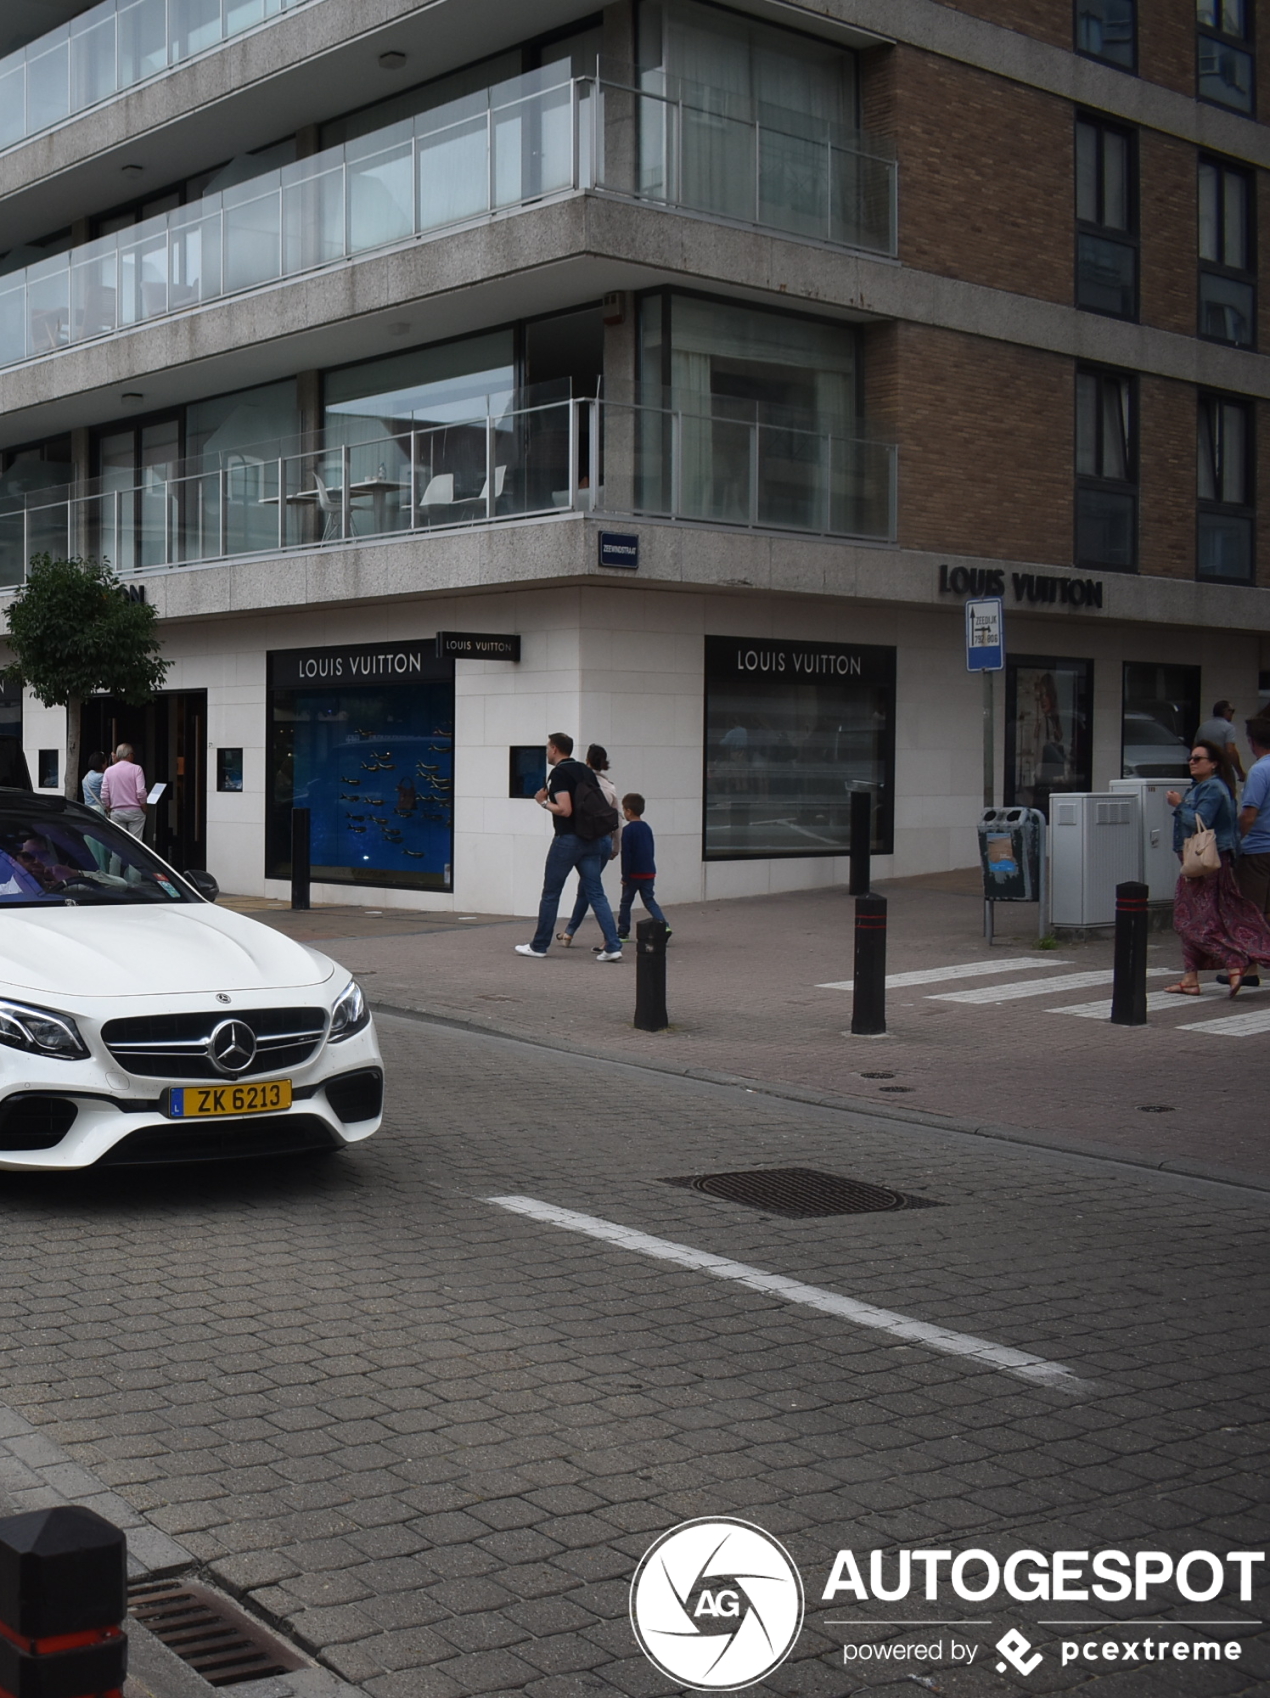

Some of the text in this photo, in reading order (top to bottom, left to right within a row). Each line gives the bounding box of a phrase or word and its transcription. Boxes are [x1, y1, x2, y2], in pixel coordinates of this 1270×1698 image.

[939, 564, 1103, 609] LOUIS VUITTON
[976, 616, 997, 625] ZEEDIJK
[446, 640, 512, 652] LOUIS VUITTON
[299, 652, 421, 678] LOUIS VUITTON
[737, 650, 861, 675] LOUIS VUITTON
[198, 1085, 280, 1112] ZK 6213
